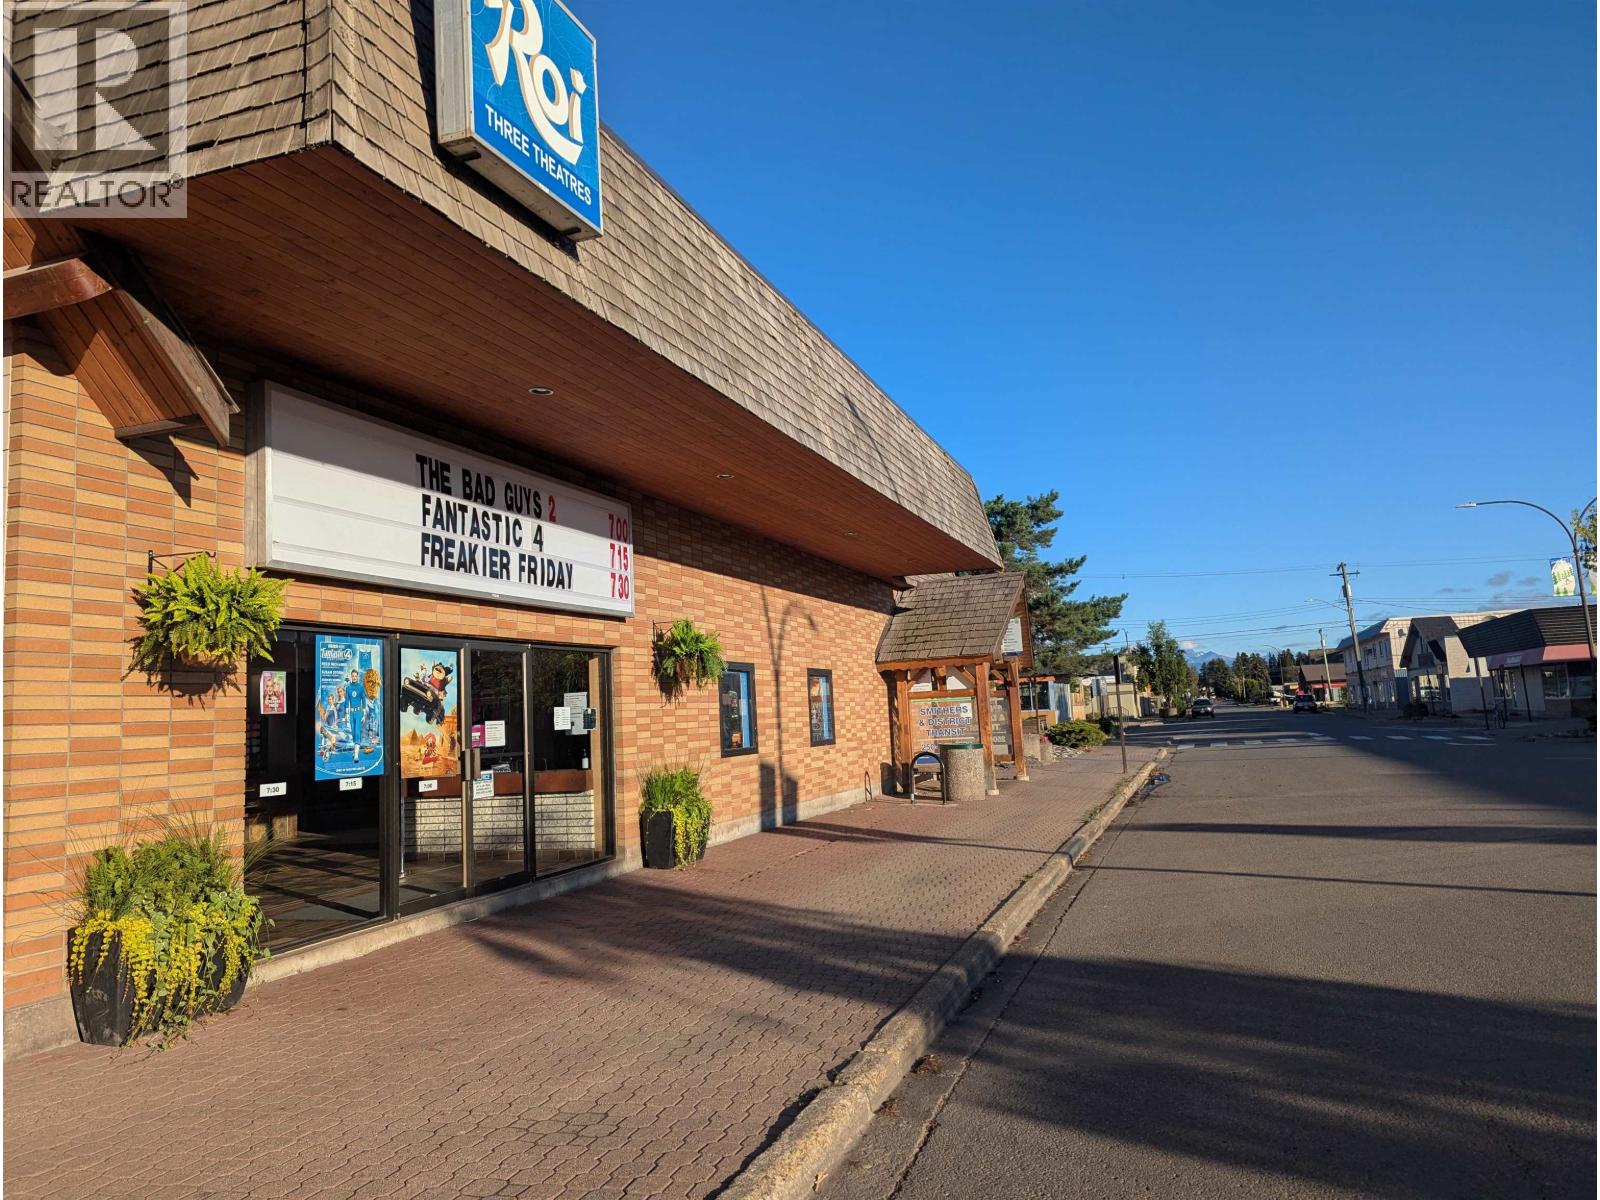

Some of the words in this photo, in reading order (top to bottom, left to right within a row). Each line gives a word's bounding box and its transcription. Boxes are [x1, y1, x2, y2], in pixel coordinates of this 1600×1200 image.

[485, 0, 587, 165] Roi
[485, 104, 530, 157] THREE
[532, 143, 592, 206] THEATRES
[416, 453, 451, 496] THE
[462, 469, 495, 507] BAD
[504, 482, 542, 519] GUYS
[548, 496, 556, 523] 2
[422, 494, 523, 548] FANTASTIC
[533, 524, 544, 552] 4
[608, 513, 628, 542] 700
[421, 532, 510, 580] FREAKIER
[519, 554, 573, 590] FRIDAY
[610, 543, 629, 571] 715
[610, 573, 630, 600] 730
[919, 719, 925, 727] &
[928, 717, 972, 726] DISTRICT
[920, 706, 968, 716] SMITHERS
[926, 728, 966, 737] TRANSIT
[266, 786, 280, 794] 7:30
